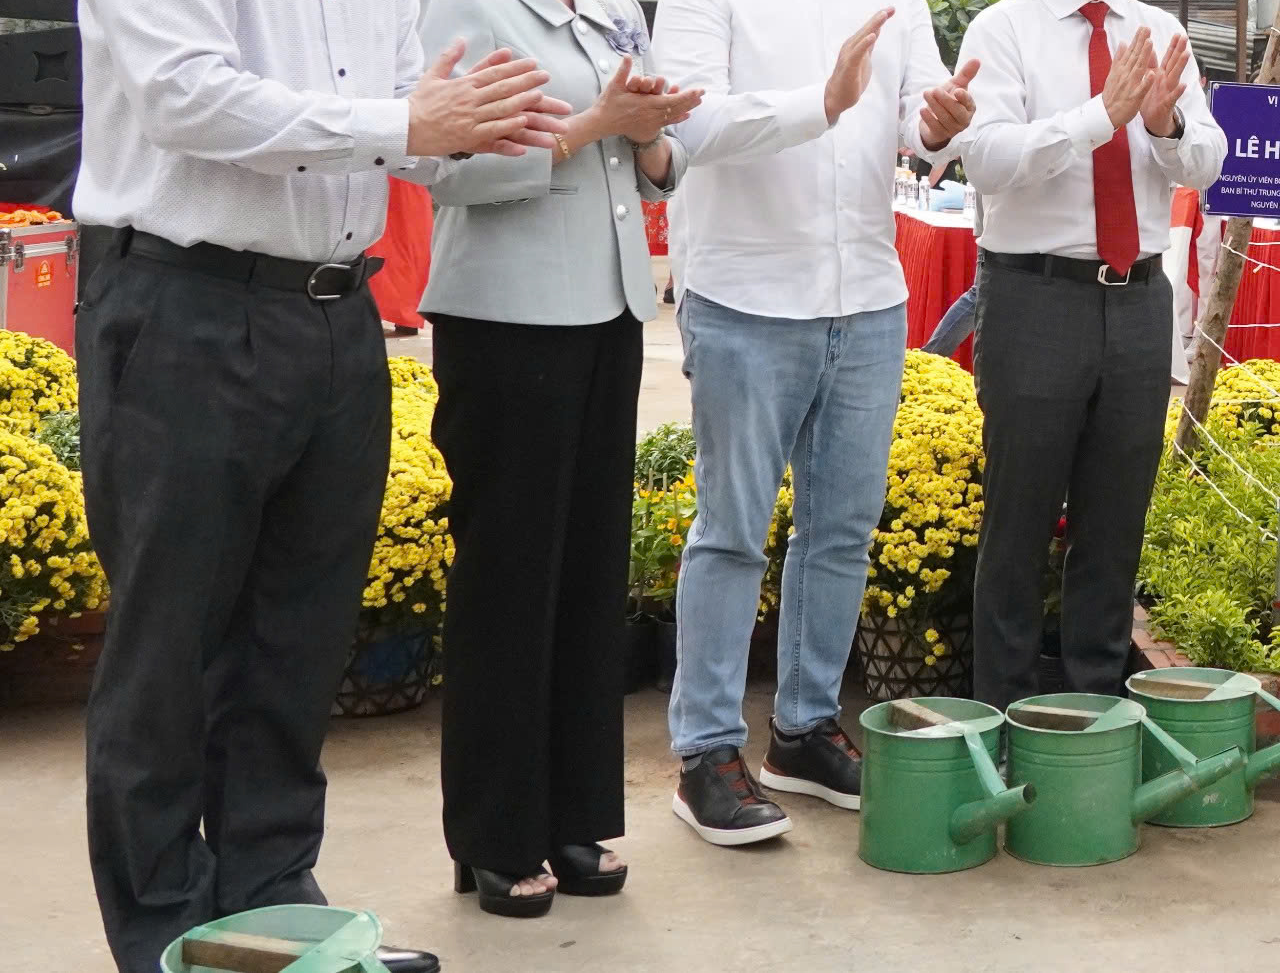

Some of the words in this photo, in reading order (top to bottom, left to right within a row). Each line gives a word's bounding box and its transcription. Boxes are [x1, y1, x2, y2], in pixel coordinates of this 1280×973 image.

[1268, 95, 1278, 108] VỊ
[1235, 135, 1259, 158] LÊ
[1258, 176, 1273, 184] VIÊN
[1221, 187, 1235, 195] BAN
[1259, 189, 1280, 197] TRUNG
